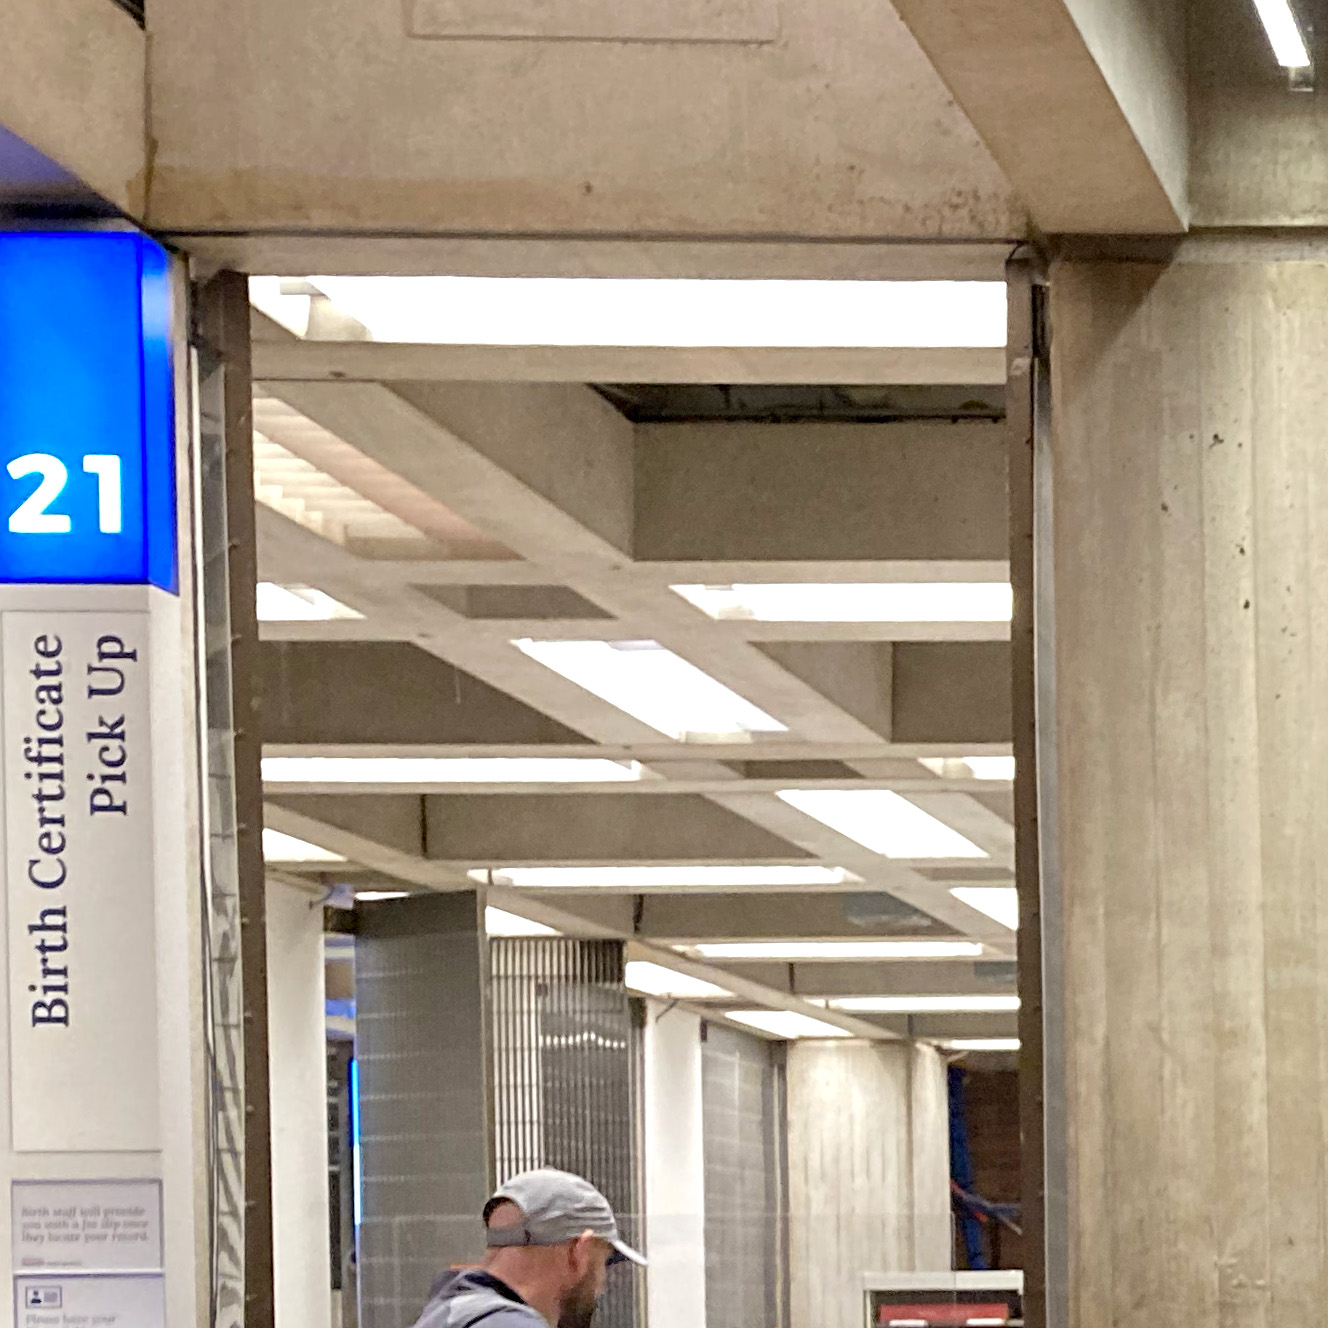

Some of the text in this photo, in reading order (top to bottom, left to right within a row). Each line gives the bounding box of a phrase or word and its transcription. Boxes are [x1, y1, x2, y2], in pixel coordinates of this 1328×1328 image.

[7, 453, 123, 535] 21
[87, 634, 138, 817] Pick Up
[24, 633, 70, 1029] Birth Certificate
